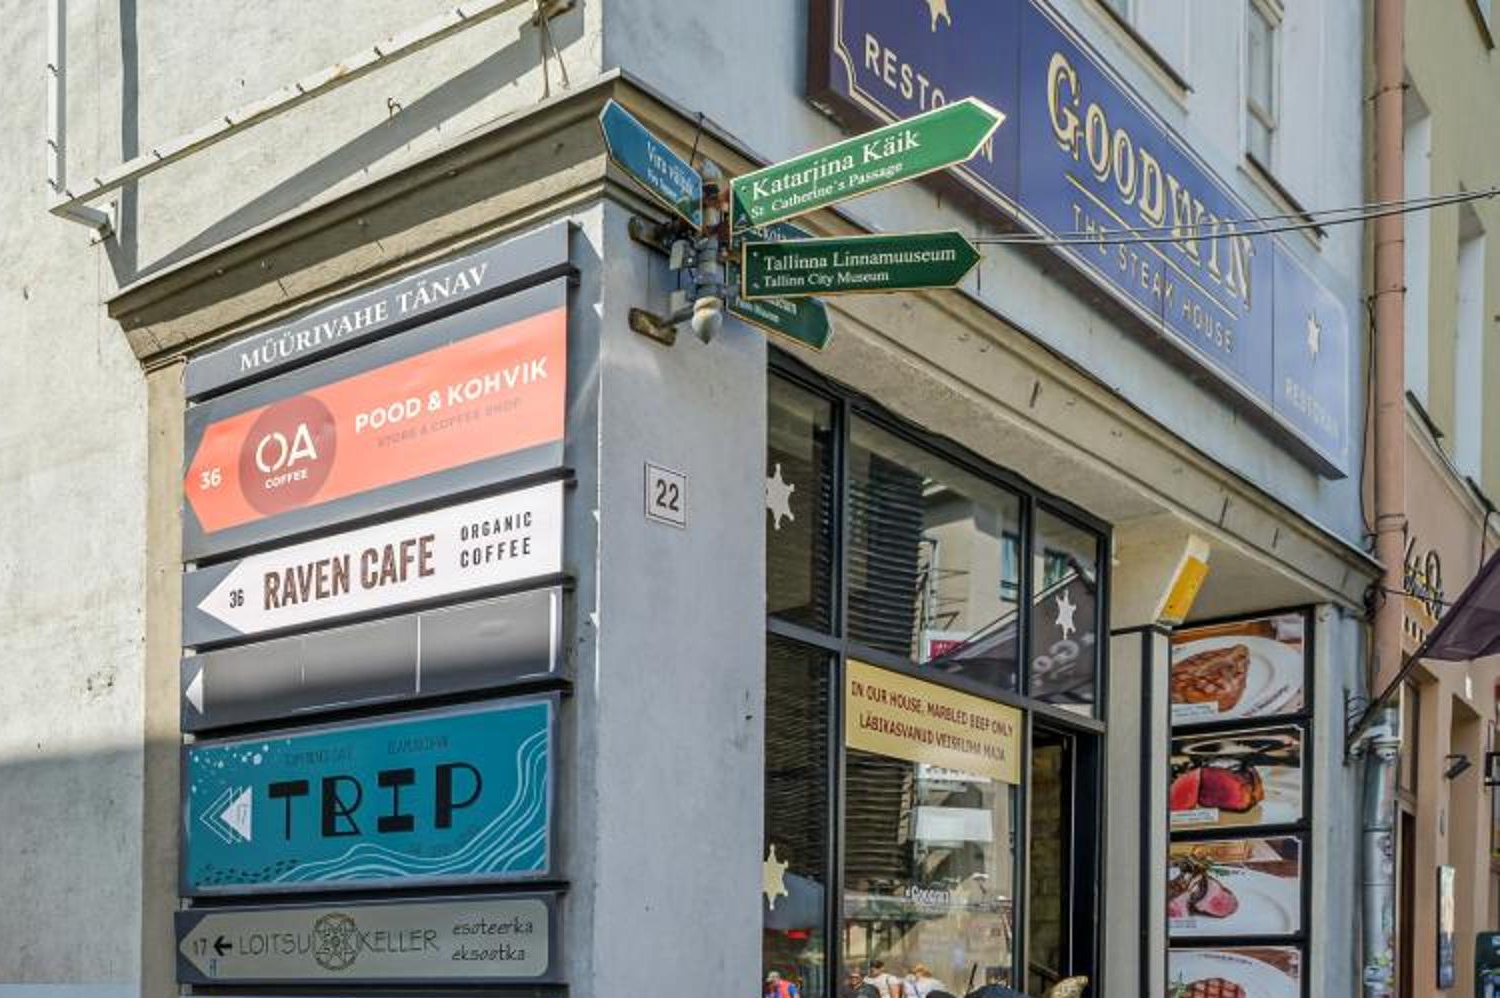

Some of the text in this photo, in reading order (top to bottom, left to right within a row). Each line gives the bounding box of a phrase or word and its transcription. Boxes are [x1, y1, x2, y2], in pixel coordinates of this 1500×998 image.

[862, 129, 921, 164] Käik
[848, 162, 903, 188] Passage
[1047, 51, 1253, 310] GOODWIN
[763, 248, 957, 272] Tallinna Linnamuuseum
[763, 270, 890, 289] Tallinn City Museum
[1072, 203, 1234, 353] THE STEAK HOUSE
[239, 262, 489, 372] MÜÜRIVAHE TÄNAV
[354, 355, 548, 434] POOD & KOHVIK
[255, 422, 319, 475] OA
[199, 468, 223, 491] 36
[264, 468, 309, 490] COFFEE
[655, 478, 680, 512] 22
[460, 510, 533, 541] ORGANIC
[459, 537, 532, 569] COFFEE
[263, 533, 437, 611] RAVEN CAFE
[229, 588, 245, 609] 36
[850, 681, 865, 698] IN
[866, 684, 888, 705] OUR
[926, 701, 970, 726] MARBLED
[267, 761, 483, 842] TRIP
[193, 937, 208, 957] 17
[239, 928, 442, 956] LOITSU KELLER
